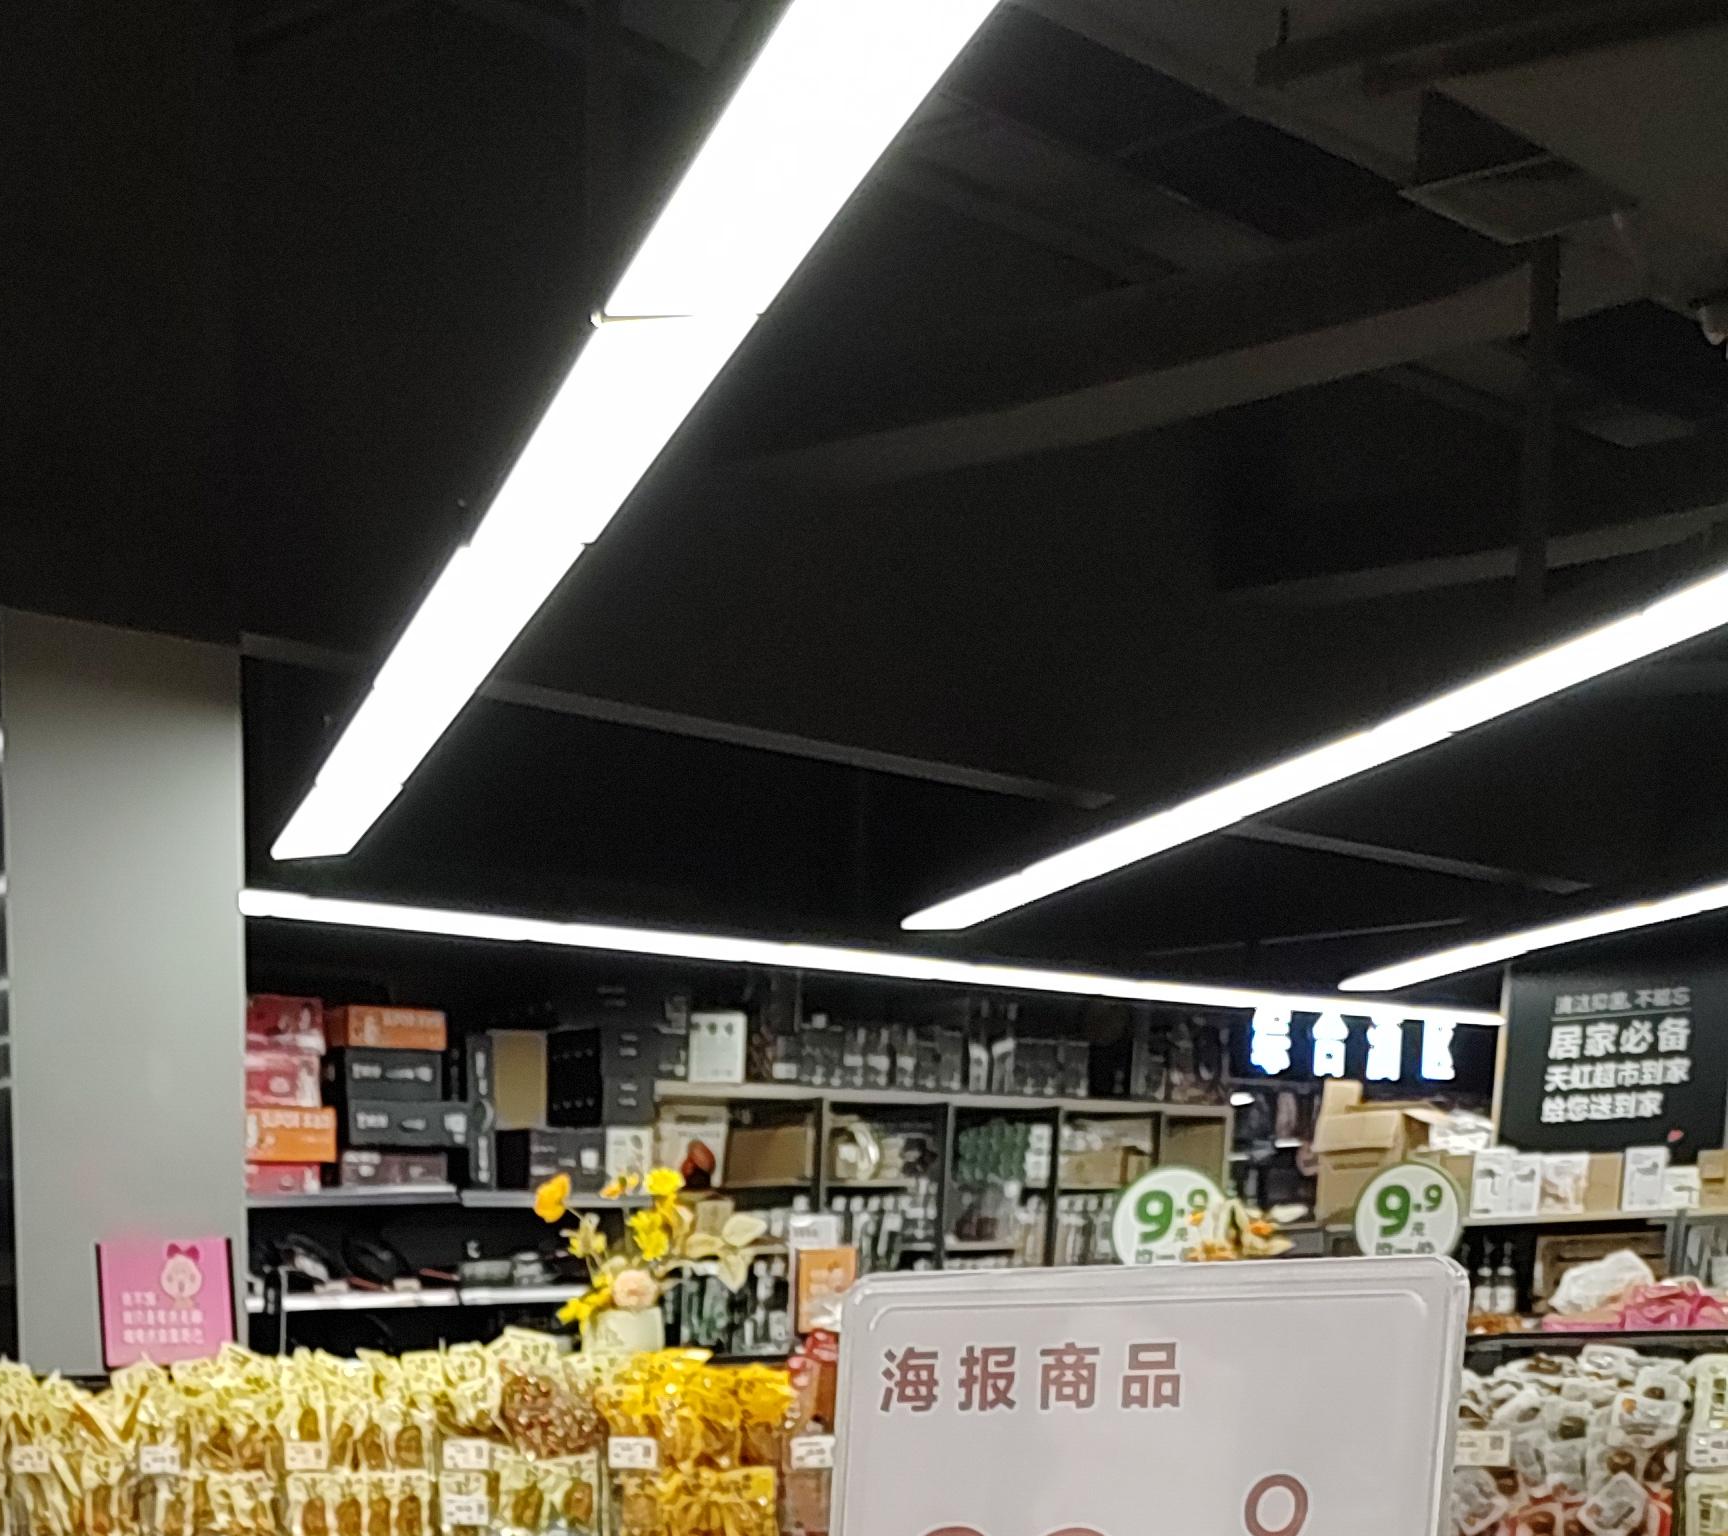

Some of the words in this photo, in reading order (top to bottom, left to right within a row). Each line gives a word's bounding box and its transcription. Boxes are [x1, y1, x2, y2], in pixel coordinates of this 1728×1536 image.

[1547, 1017, 1691, 1059] 居家必备
[880, 1342, 1180, 1412] 海报商品
